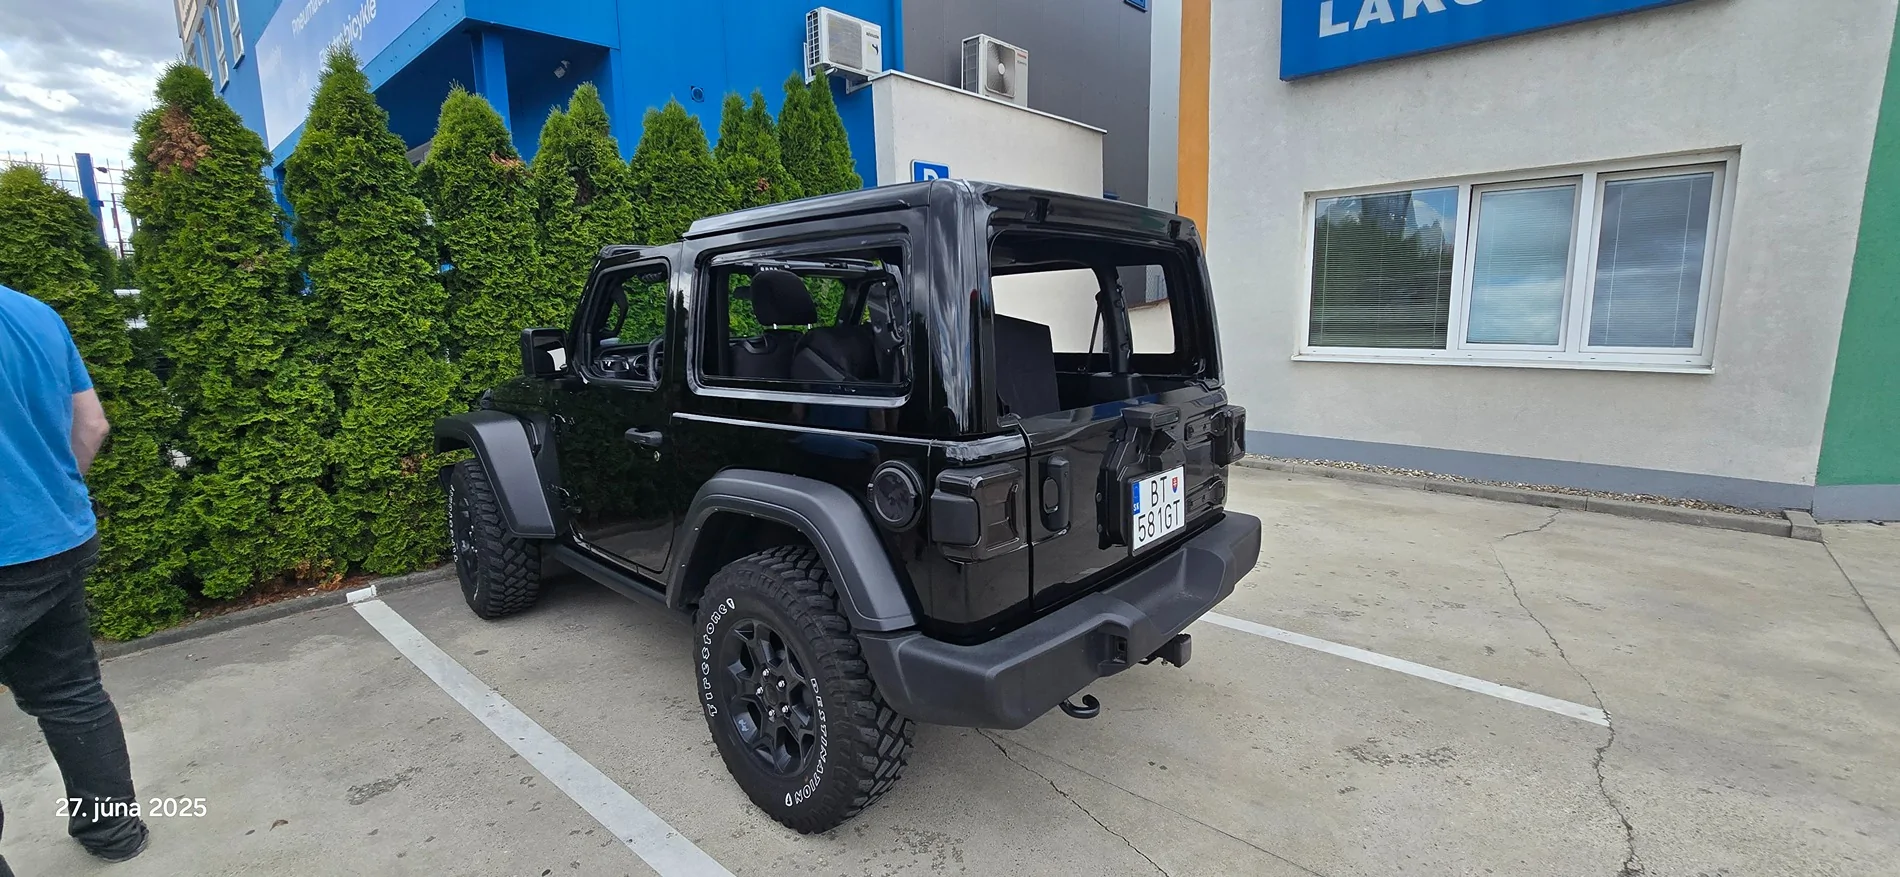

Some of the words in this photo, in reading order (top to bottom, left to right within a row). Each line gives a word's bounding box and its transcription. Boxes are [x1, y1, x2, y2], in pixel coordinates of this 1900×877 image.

[1133, 502, 1140, 512] SK
[1150, 476, 1168, 507] BT
[1138, 499, 1181, 542] 581GT
[794, 678, 829, 805] DESTINATION
